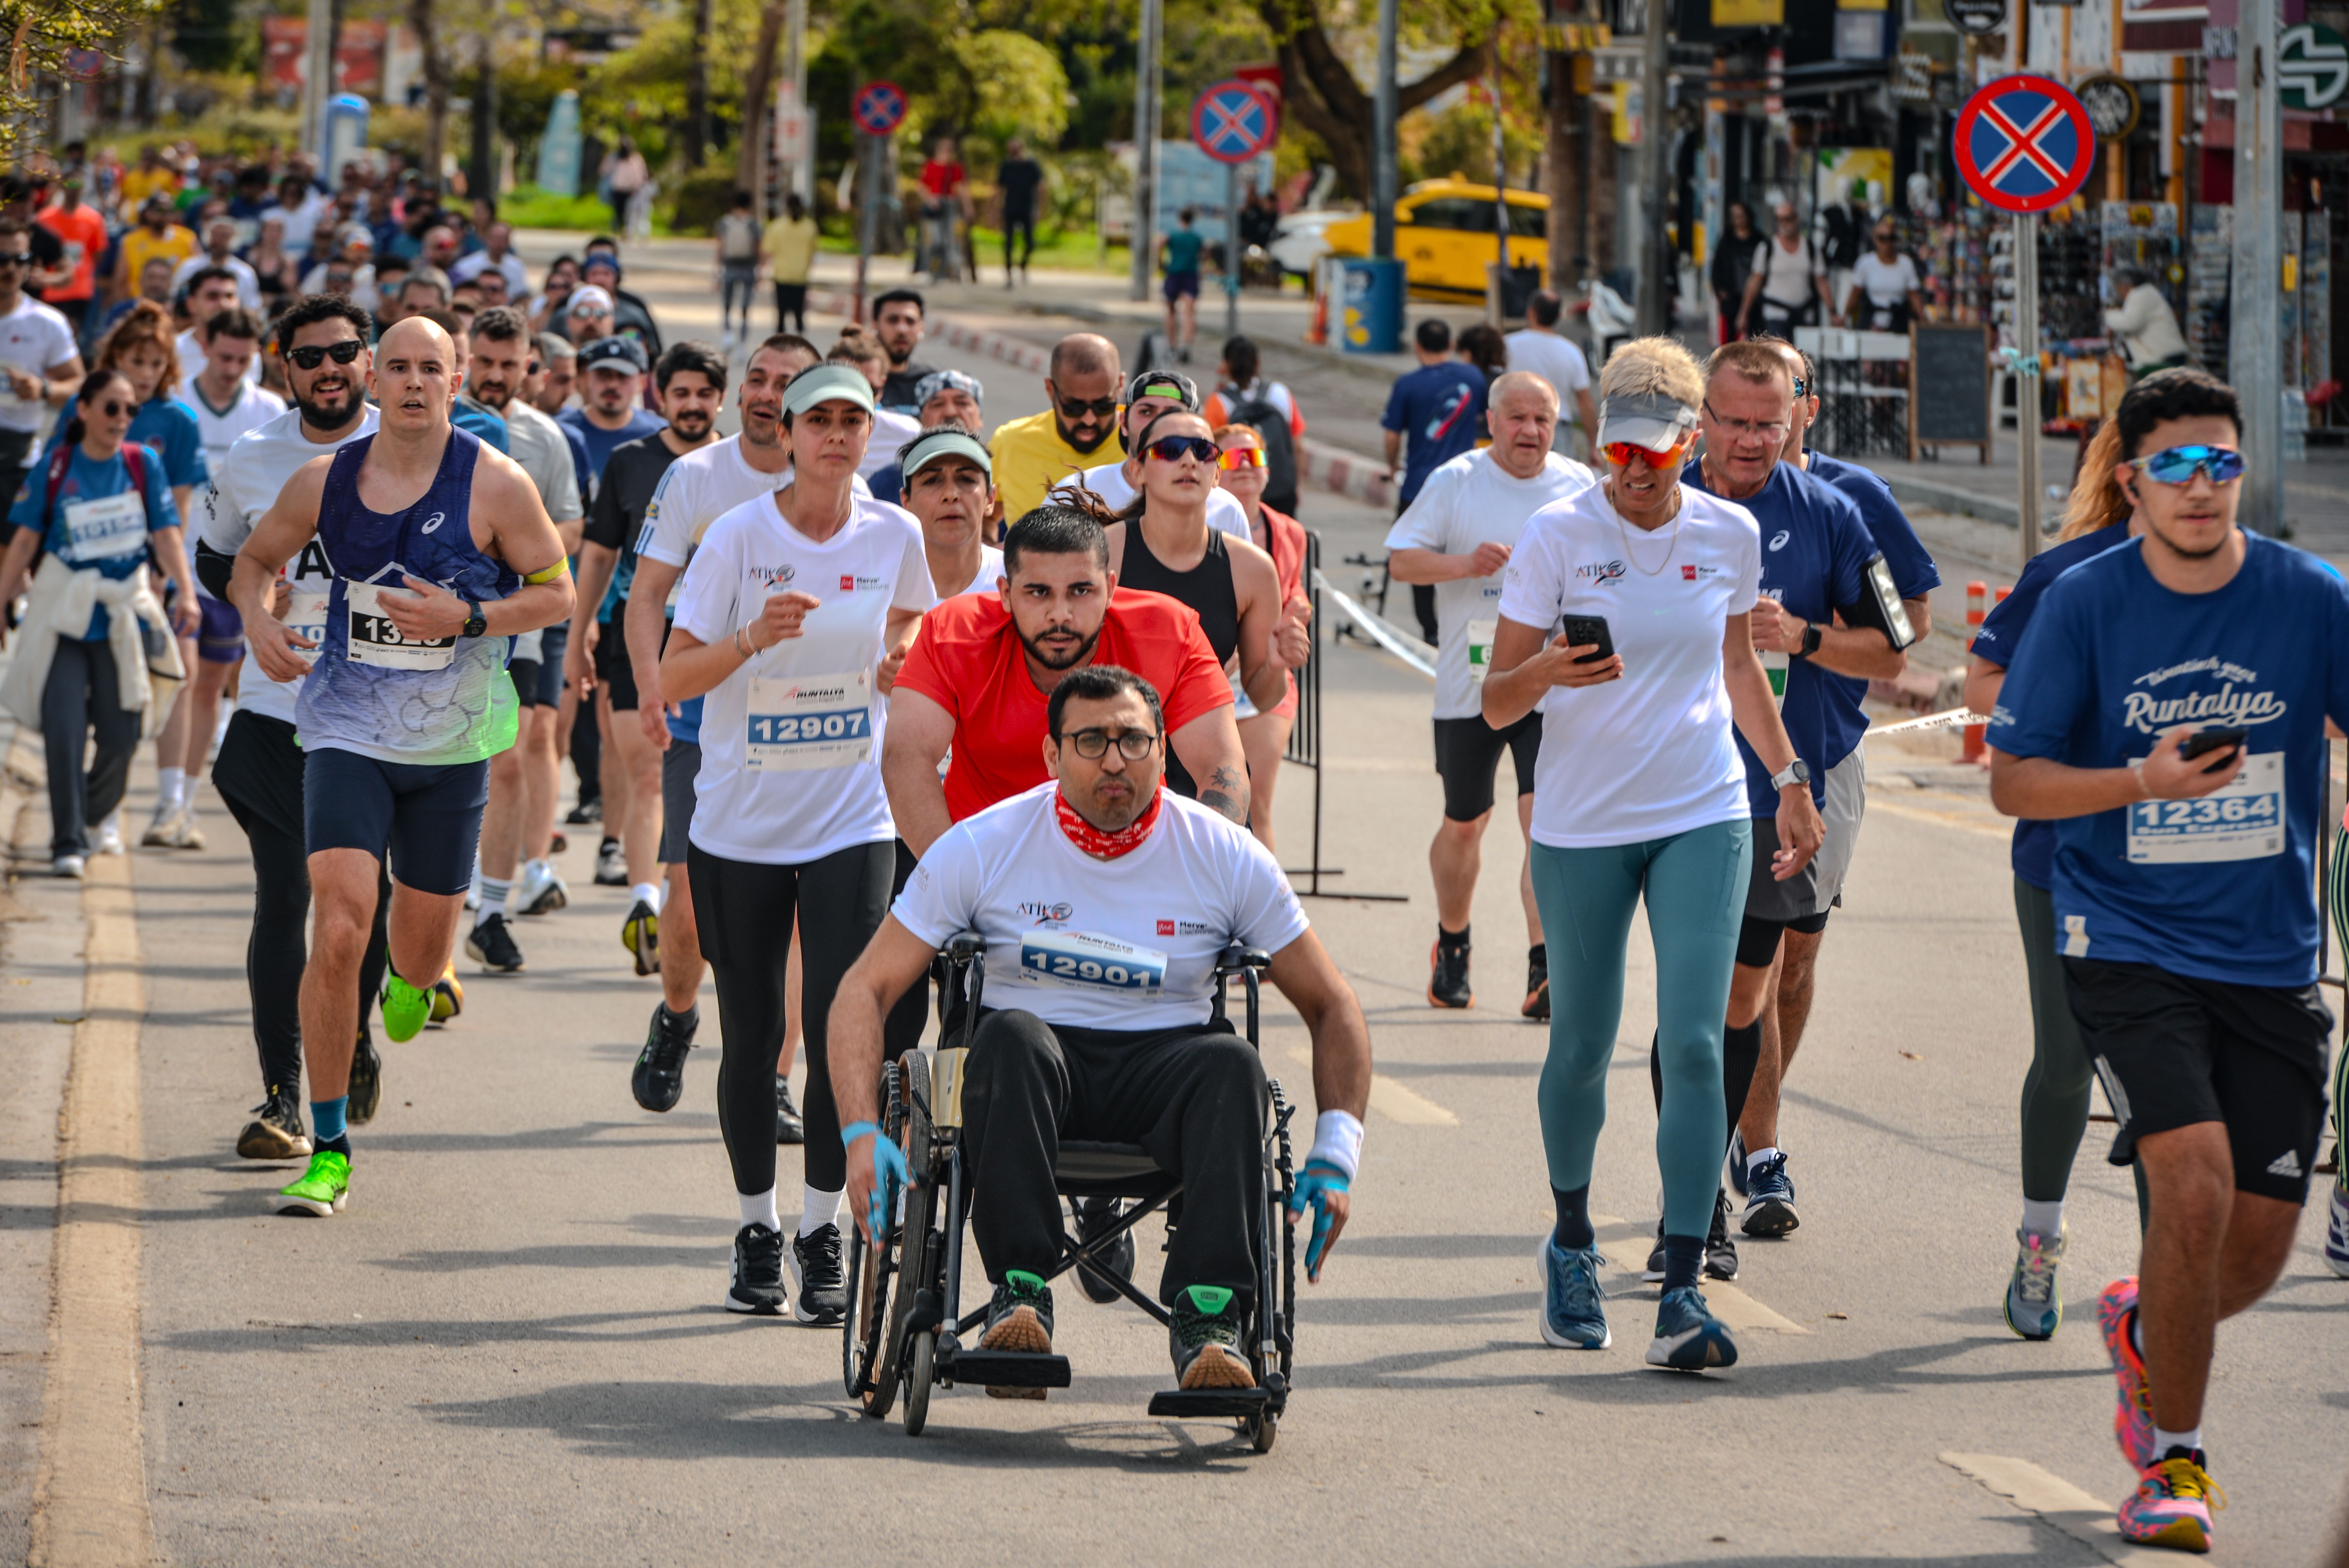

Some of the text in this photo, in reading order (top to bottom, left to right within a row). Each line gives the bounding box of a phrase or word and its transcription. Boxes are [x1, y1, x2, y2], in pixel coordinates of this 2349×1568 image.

[365, 618, 442, 646] 13
[2123, 682, 2287, 734] Runtalya
[756, 711, 864, 741] 12907
[2137, 794, 2276, 826] 12364
[2136, 819, 2275, 835] Sun Express
[1030, 952, 1150, 987] 12901
